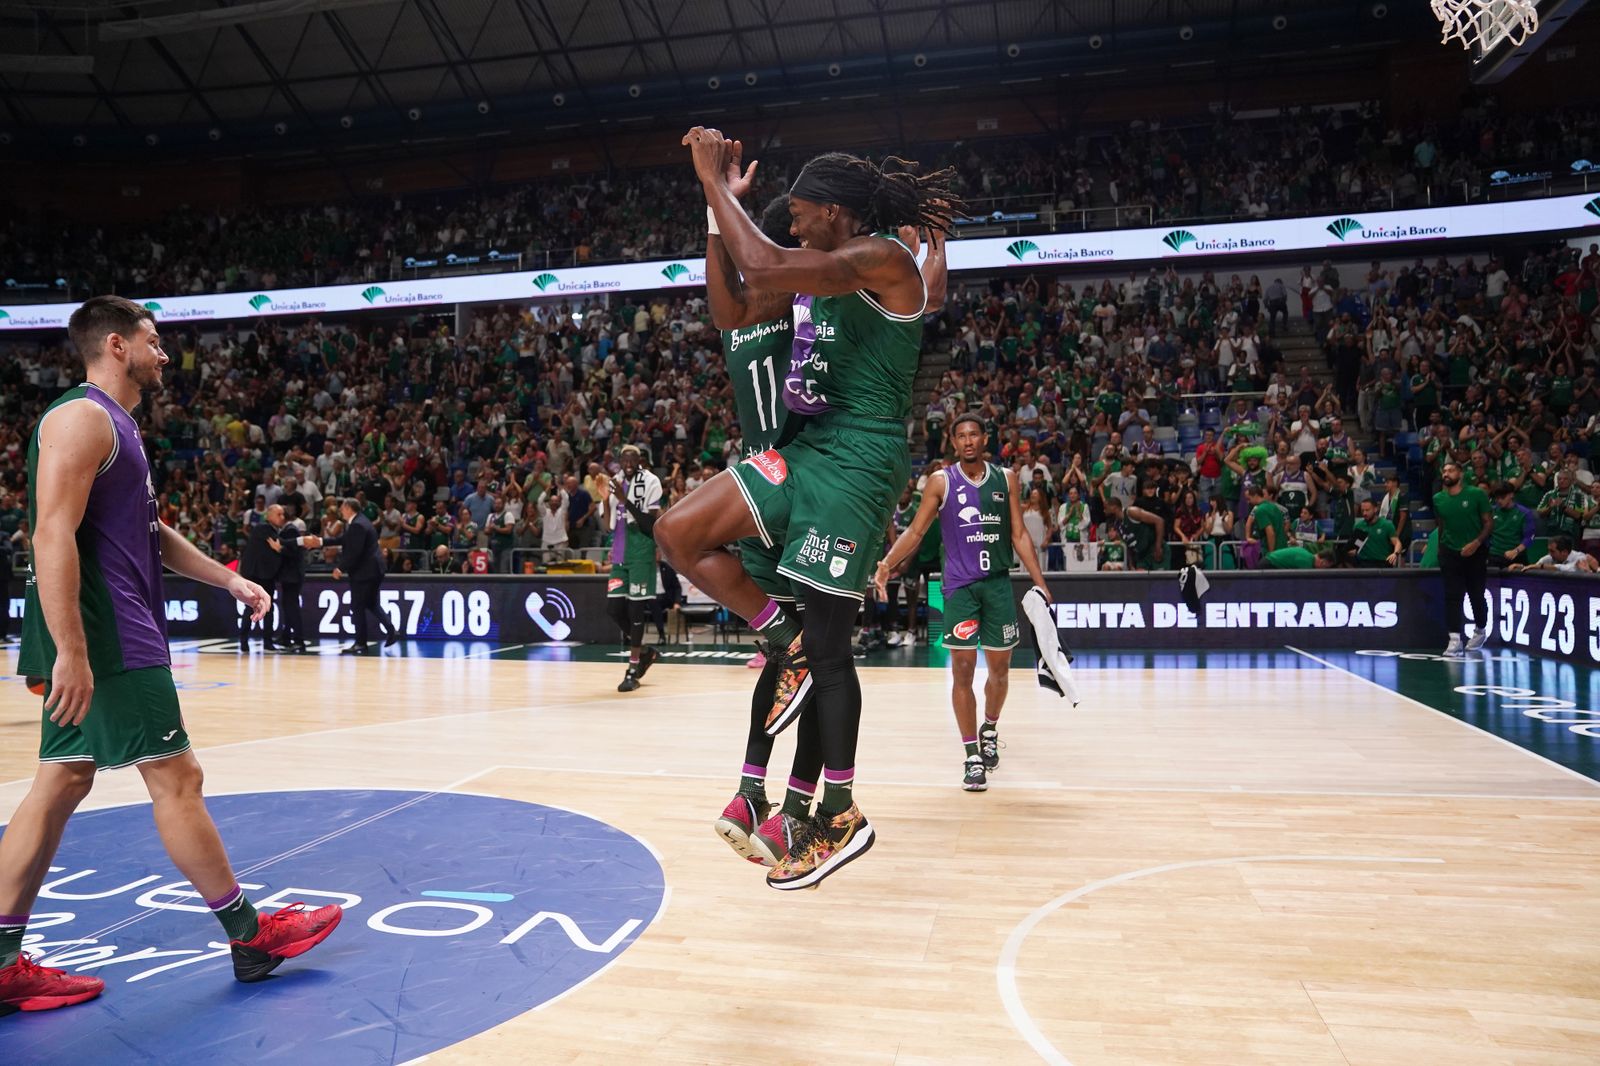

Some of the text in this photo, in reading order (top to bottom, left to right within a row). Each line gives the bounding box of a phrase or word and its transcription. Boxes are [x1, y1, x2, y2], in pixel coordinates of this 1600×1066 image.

[1361, 225, 1447, 240] Unicaja Banco
[1195, 237, 1275, 251] Unicaja Banco
[1037, 248, 1114, 261] Unicaja Banco
[557, 280, 621, 292] Unicaja Banco
[385, 293, 443, 304] Unicaja Banco
[161, 308, 190, 318] Unicaja
[270, 301, 326, 312] Unicaja Banco
[9, 317, 38, 326] Unicaja
[748, 355, 778, 431] 11
[836, 543, 850, 552] acb
[475, 556, 487, 572] 5
[980, 550, 991, 571] 6
[442, 590, 491, 637] 08
[1153, 603, 1198, 628] DE
[1206, 601, 1398, 628] ENTRADAS
[1541, 592, 1575, 655] 23
